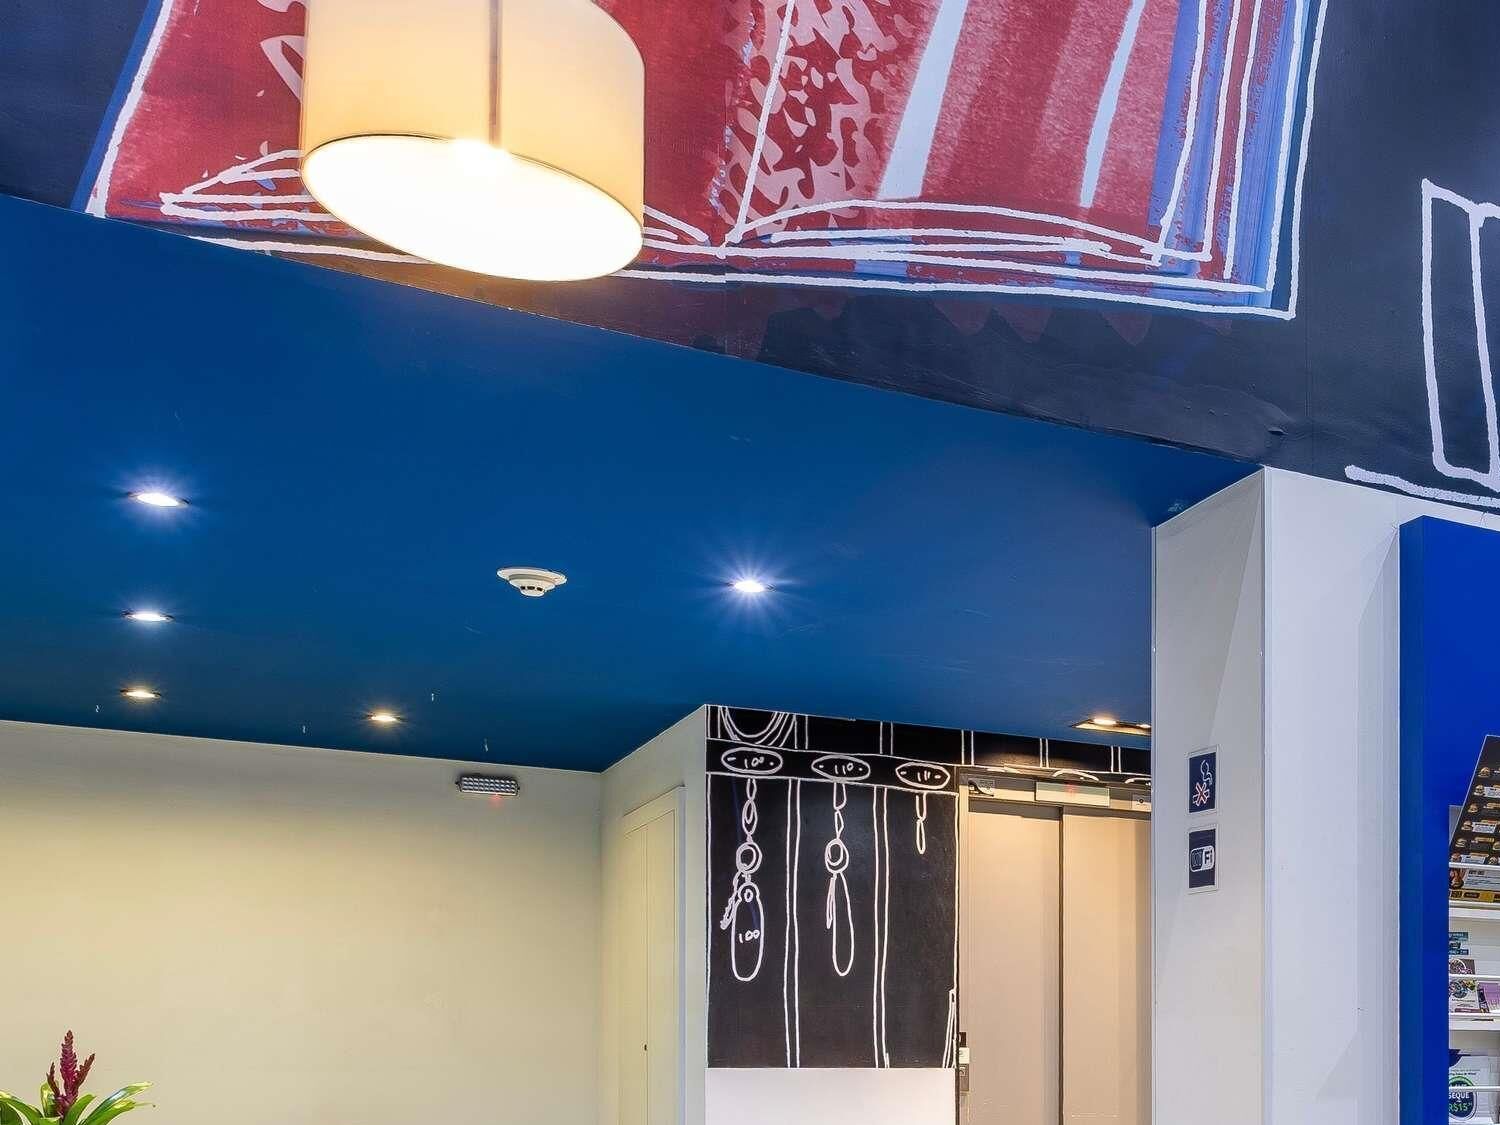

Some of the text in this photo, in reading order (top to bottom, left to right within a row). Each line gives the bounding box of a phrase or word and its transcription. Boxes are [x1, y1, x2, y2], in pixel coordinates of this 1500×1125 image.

[744, 756, 765, 769] 100
[834, 762, 854, 775] 110
[738, 929, 760, 944] 100
